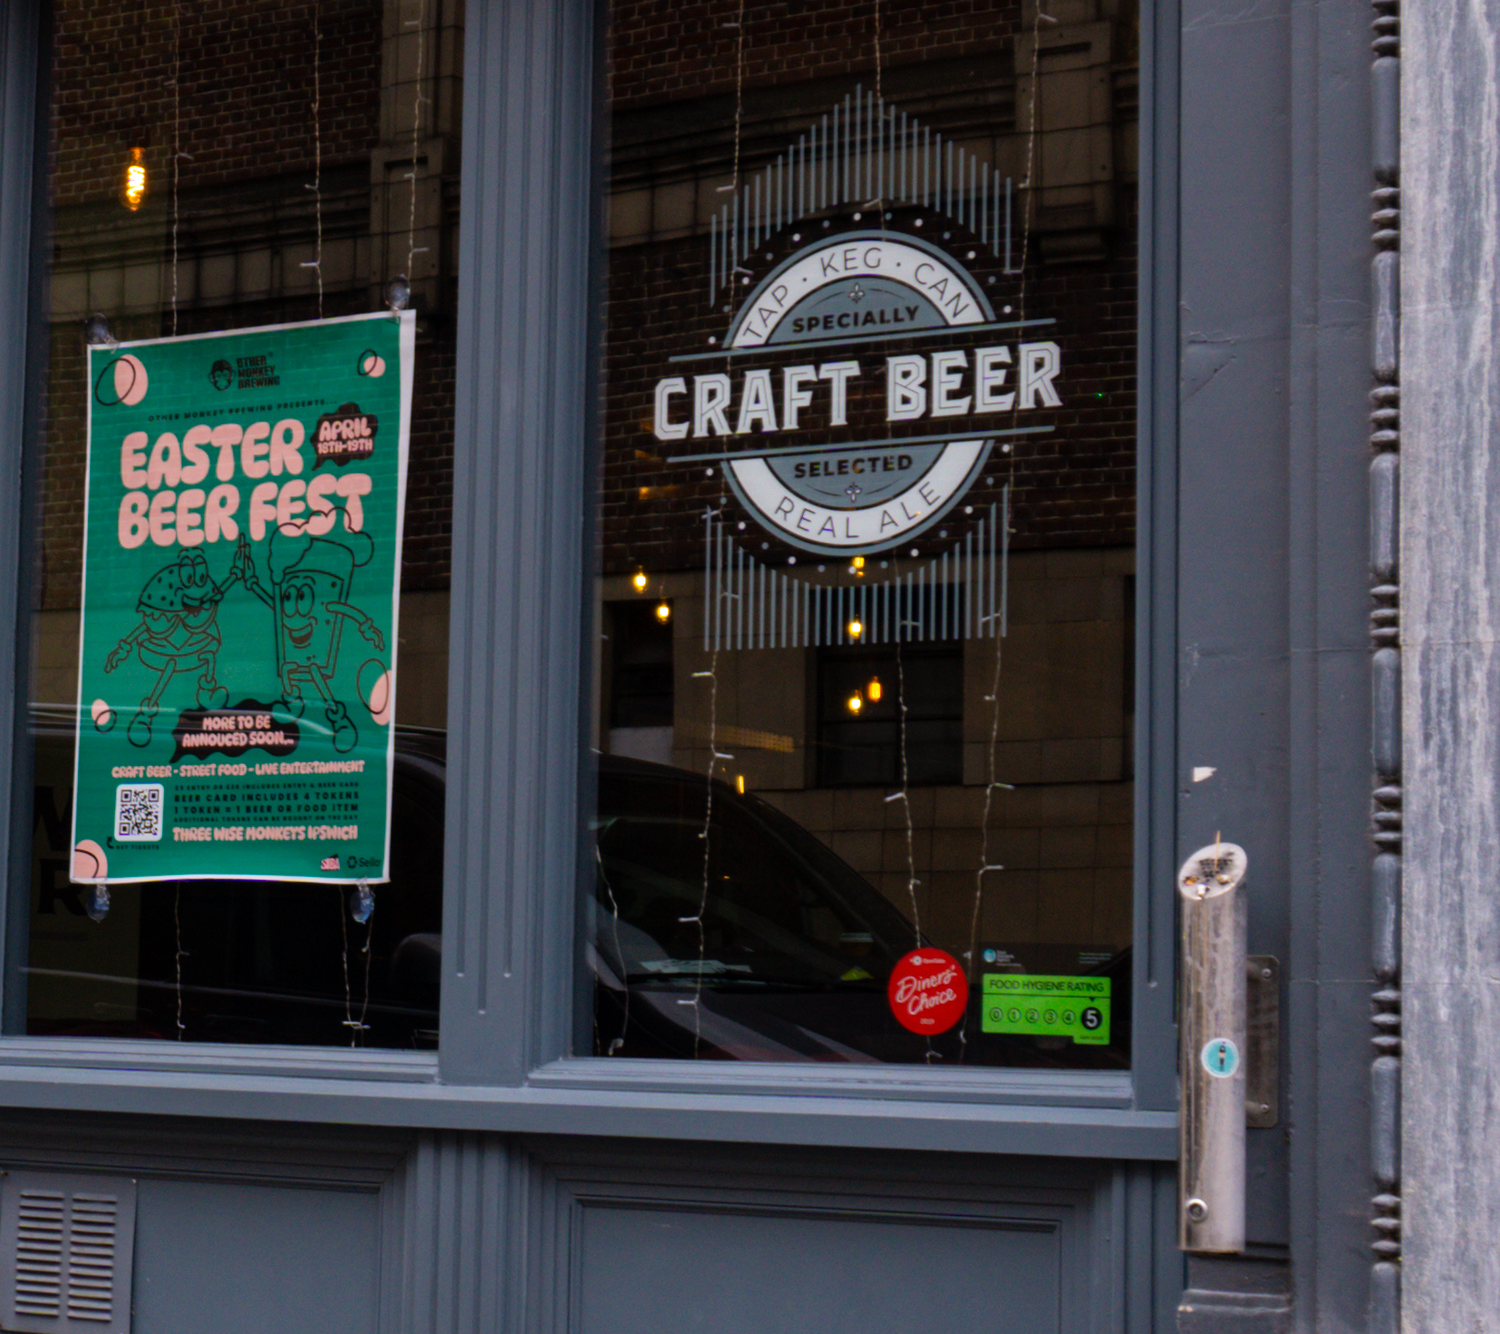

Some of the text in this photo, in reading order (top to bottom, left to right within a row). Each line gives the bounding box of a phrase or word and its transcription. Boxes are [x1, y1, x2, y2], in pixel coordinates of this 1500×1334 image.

[741, 246, 972, 341] TAP KEG CAN
[791, 304, 920, 334] SPECIALLY
[236, 354, 268, 368] OTHER
[237, 364, 277, 379] MONKEY
[237, 375, 281, 391] BREWING
[653, 340, 1063, 442] CRAFT BEER
[148, 412, 181, 423] OTHER
[183, 408, 225, 420] MONKEY
[228, 403, 274, 416] BREWING
[120, 416, 373, 491] EASTER APRIL
[316, 437, 374, 455] 18TH-19TH
[793, 453, 914, 480] SELECTED
[117, 472, 374, 550] BEER FEST
[773, 479, 943, 540] REAL ALE
[202, 714, 272, 731] MORE TO BE
[181, 731, 248, 749] ANNOUCED
[111, 765, 146, 779] CRAFT
[146, 765, 173, 779] BEER
[179, 764, 217, 778] STREET
[217, 763, 248, 777] FOOD
[255, 762, 279, 776] LIVE
[279, 759, 366, 775] ENTERTAINMENT
[173, 793, 201, 803] BEER
[205, 793, 237, 803] CARD
[241, 791, 299, 802] INCLUDES
[314, 790, 360, 801] TOKENS
[183, 805, 221, 815] TOKEN
[245, 804, 273, 814] BEER
[277, 803, 292, 813] OR
[297, 803, 328, 813] FOOD
[331, 802, 359, 813] ITEM
[172, 824, 359, 842] THREE WISE MONKEYS IPSWICH
[989, 978, 1105, 993] FOOD HYGIENE RATING
[906, 987, 957, 1016] Choice
[1085, 1009, 1099, 1028] 5
